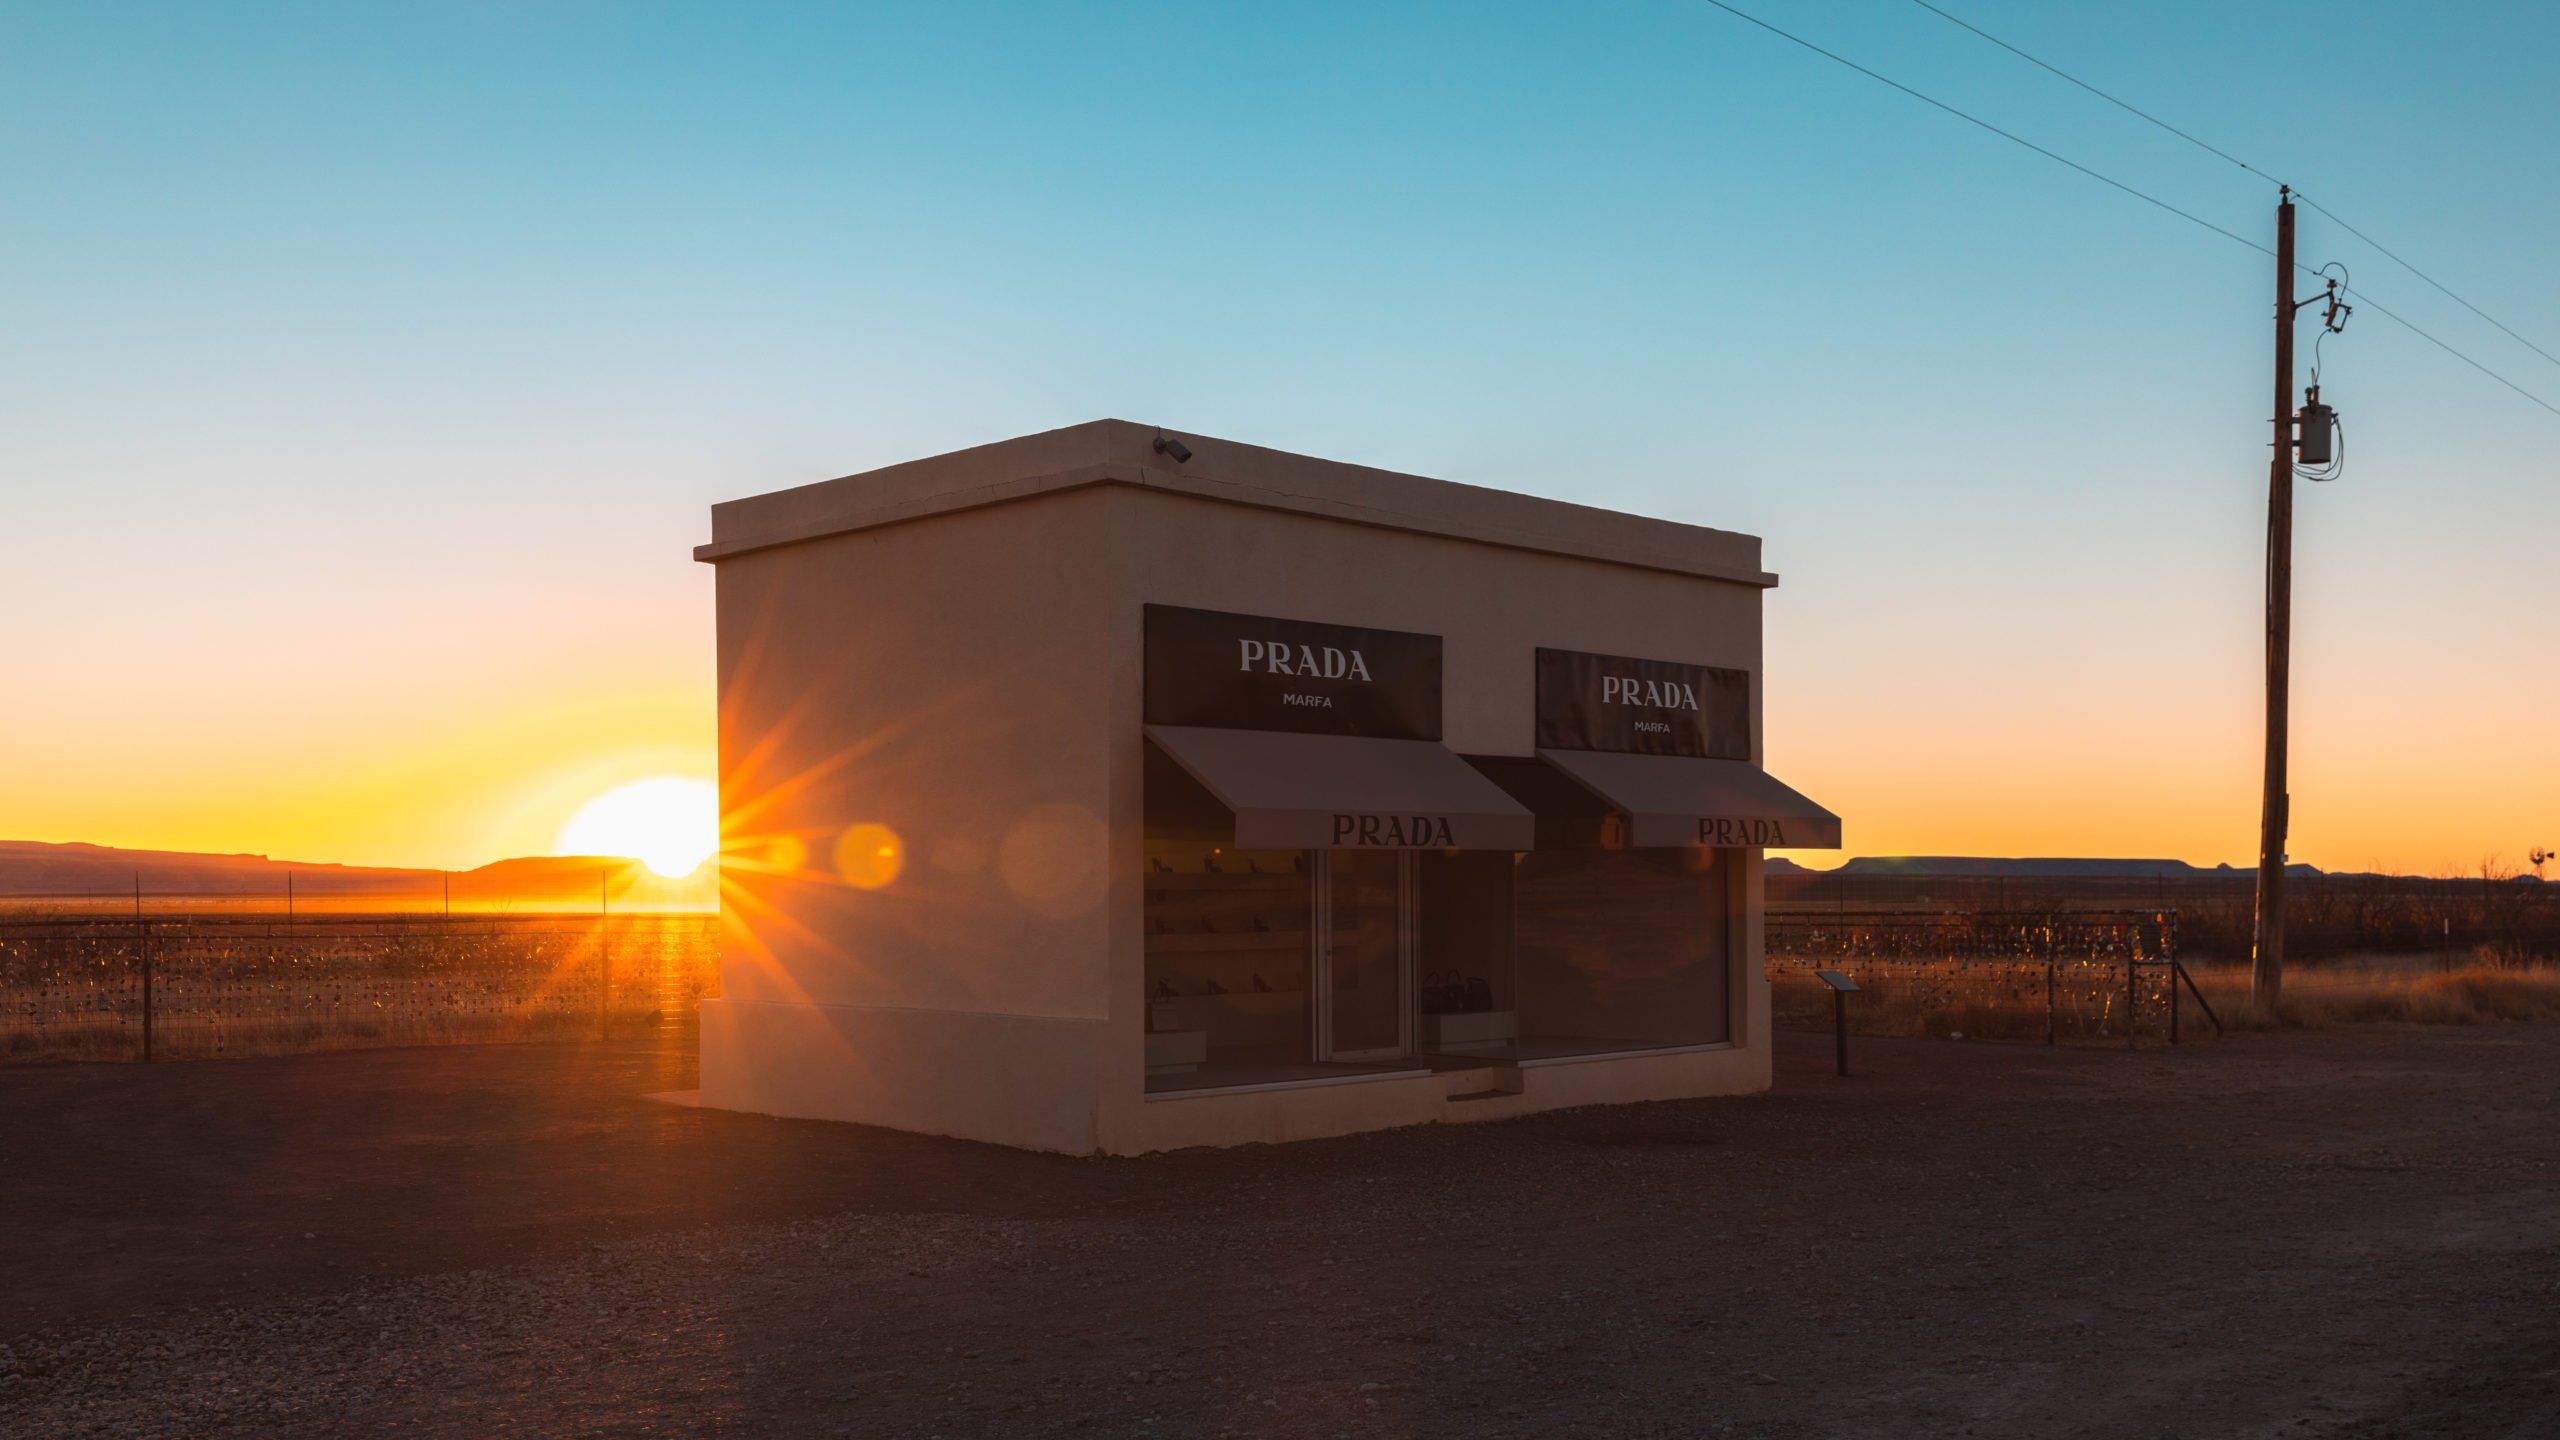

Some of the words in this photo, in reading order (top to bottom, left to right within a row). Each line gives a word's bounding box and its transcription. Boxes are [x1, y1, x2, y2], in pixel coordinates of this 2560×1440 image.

[1239, 639, 1371, 681] PRADA
[1283, 693, 1332, 707] MARFA
[1602, 676, 1698, 710] PRADA
[1634, 721, 1670, 733] MARFA
[1332, 814, 1455, 846] PRADA
[1699, 818, 1786, 845] PRADA
